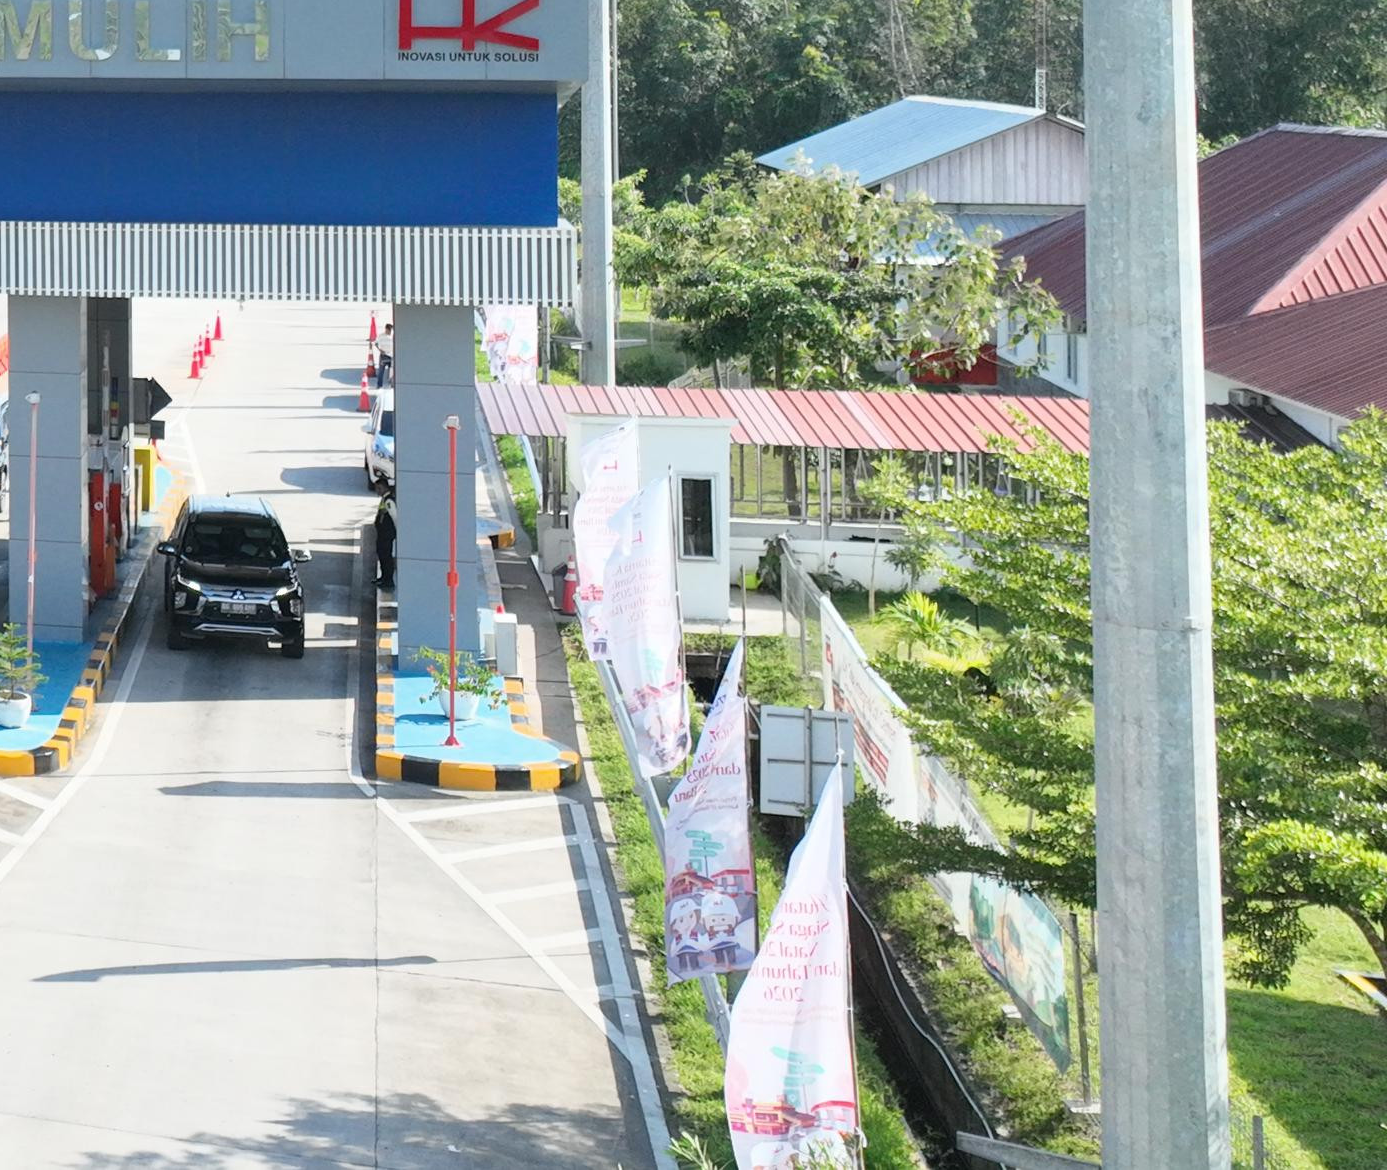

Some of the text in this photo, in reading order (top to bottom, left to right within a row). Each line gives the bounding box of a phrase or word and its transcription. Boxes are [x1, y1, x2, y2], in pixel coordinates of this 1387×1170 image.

[398, 52, 539, 63] INOVASI UNTUK SOLUSI
